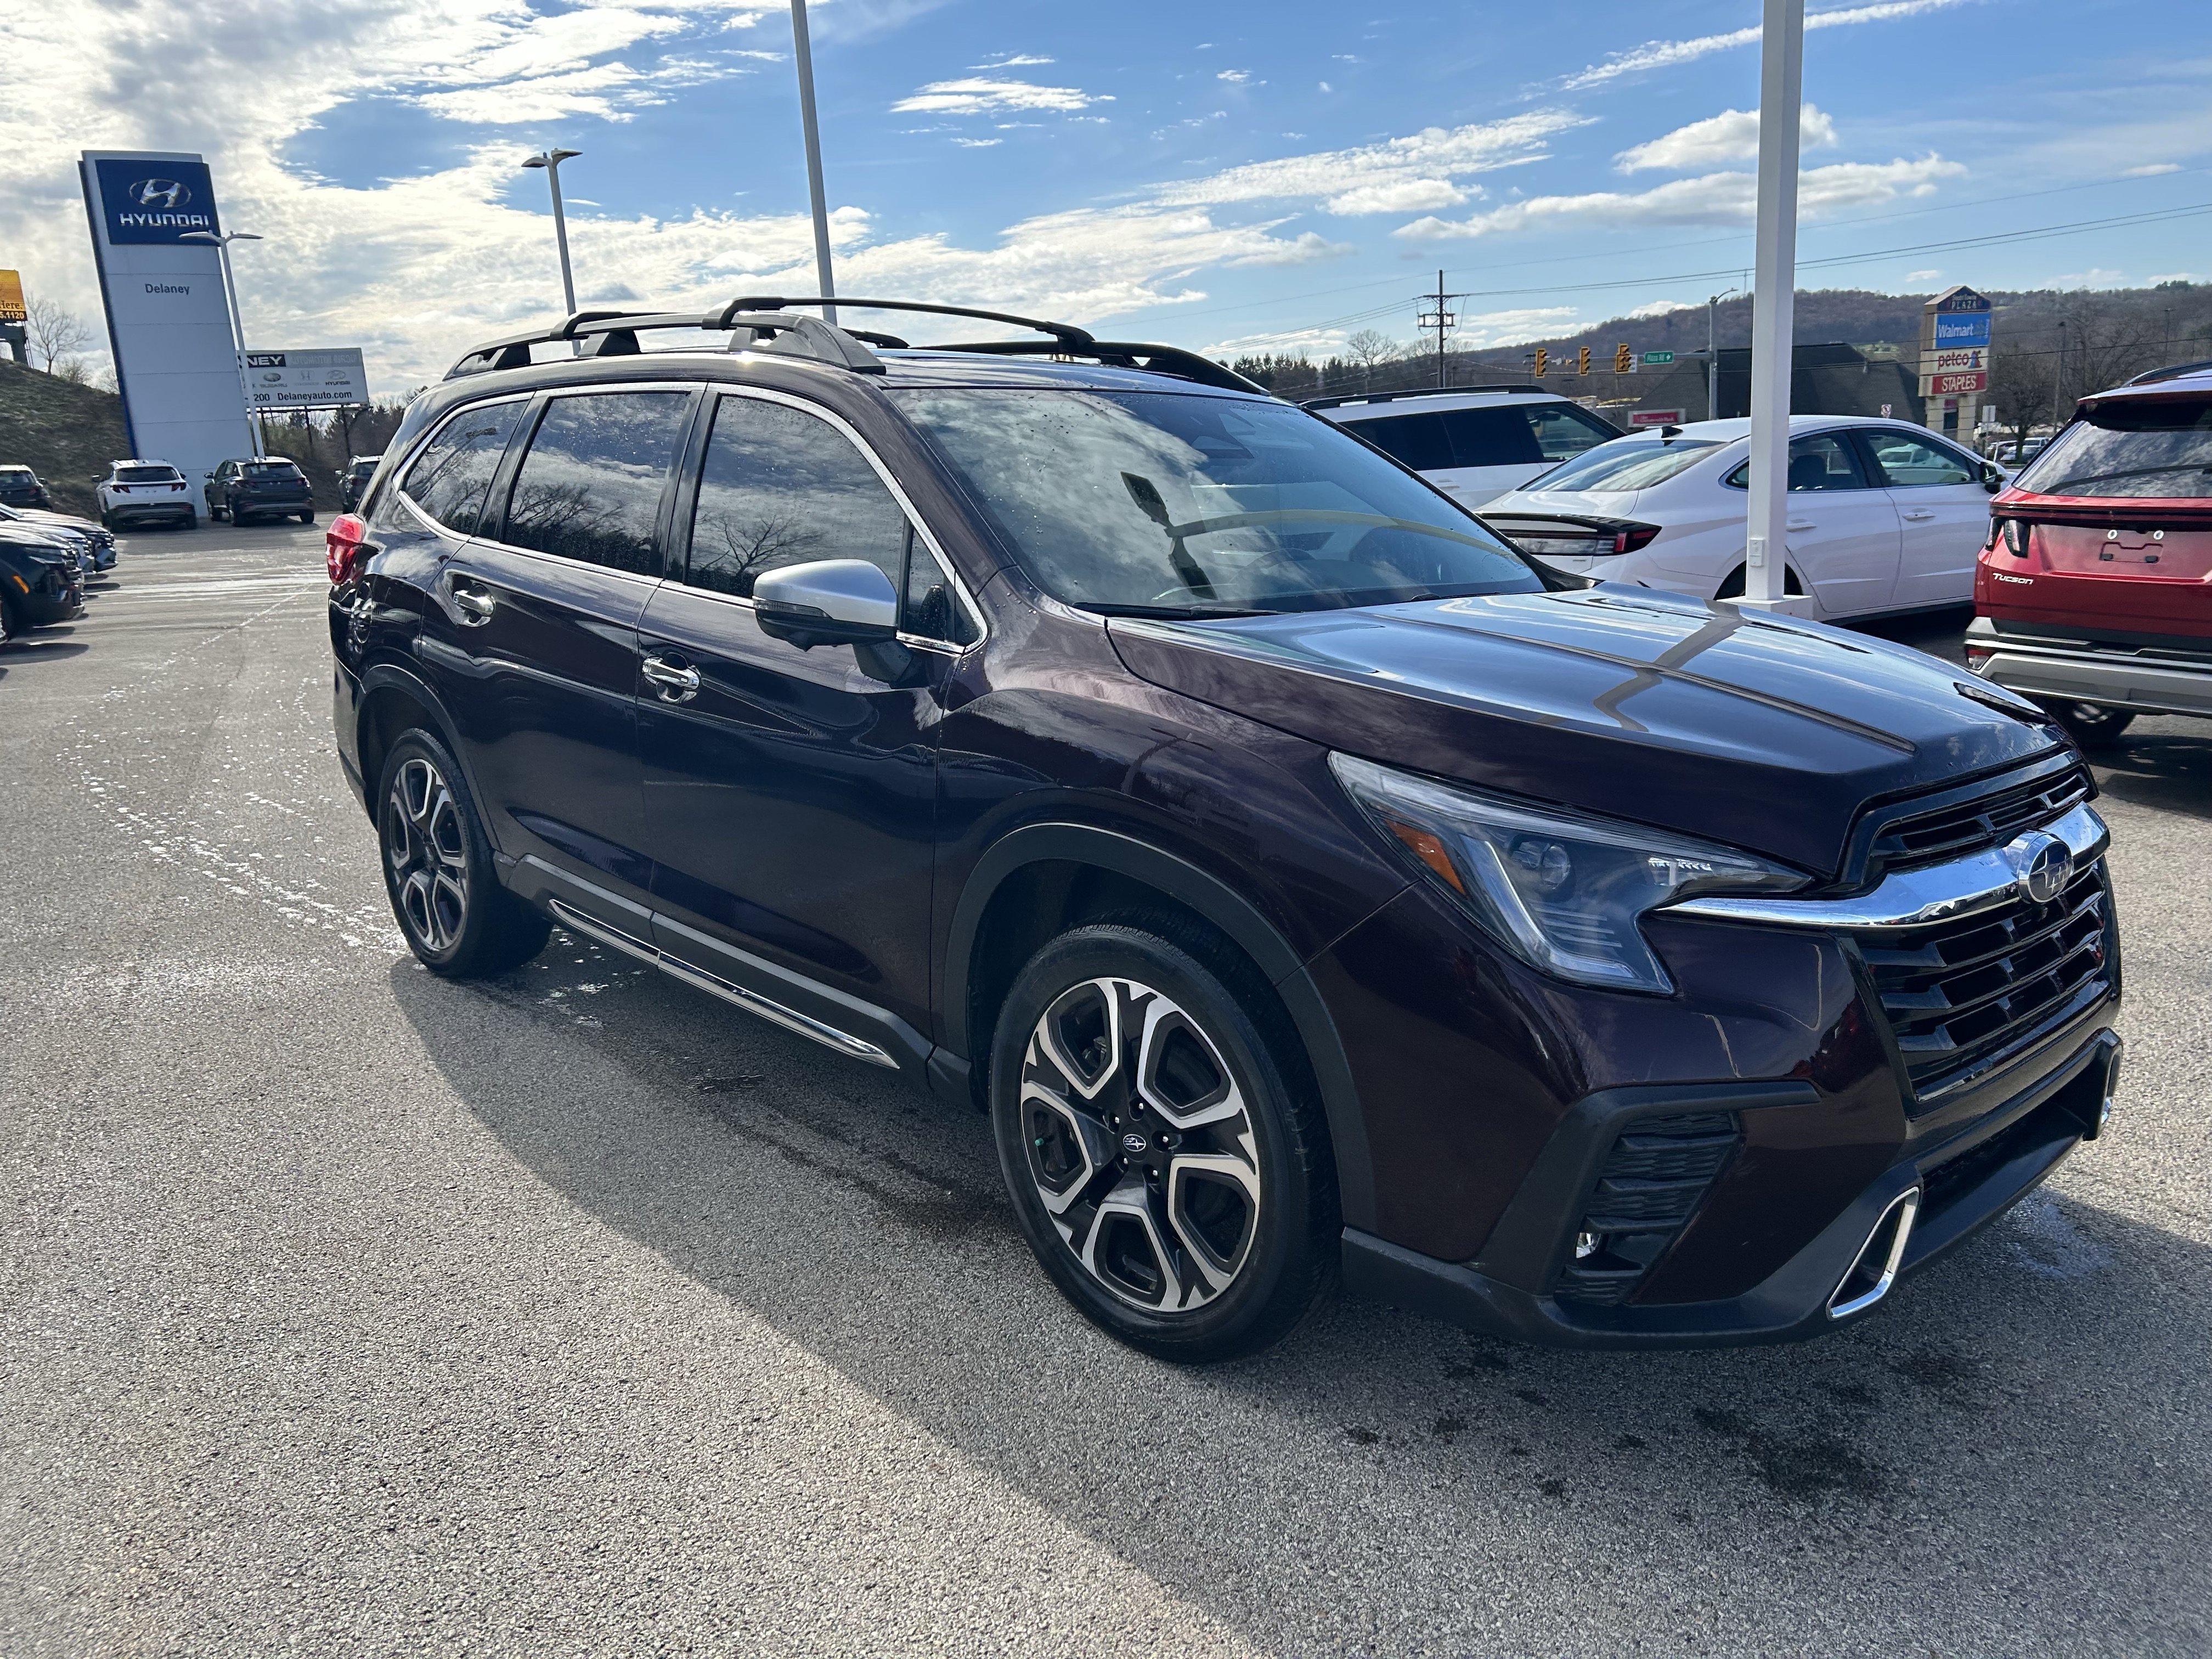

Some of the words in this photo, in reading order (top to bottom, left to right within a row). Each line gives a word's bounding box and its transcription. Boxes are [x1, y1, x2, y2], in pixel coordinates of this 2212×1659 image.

[120, 213, 209, 226] HYUNDAI
[145, 284, 190, 295] Delaney
[1951, 300, 1976, 309] PLAZA
[1938, 323, 1973, 338] Walmart
[238, 356, 282, 366] NEY
[1938, 352, 1969, 371] petco
[1942, 375, 1977, 392] STAPLES
[278, 391, 352, 402] Delaneyauto.com
